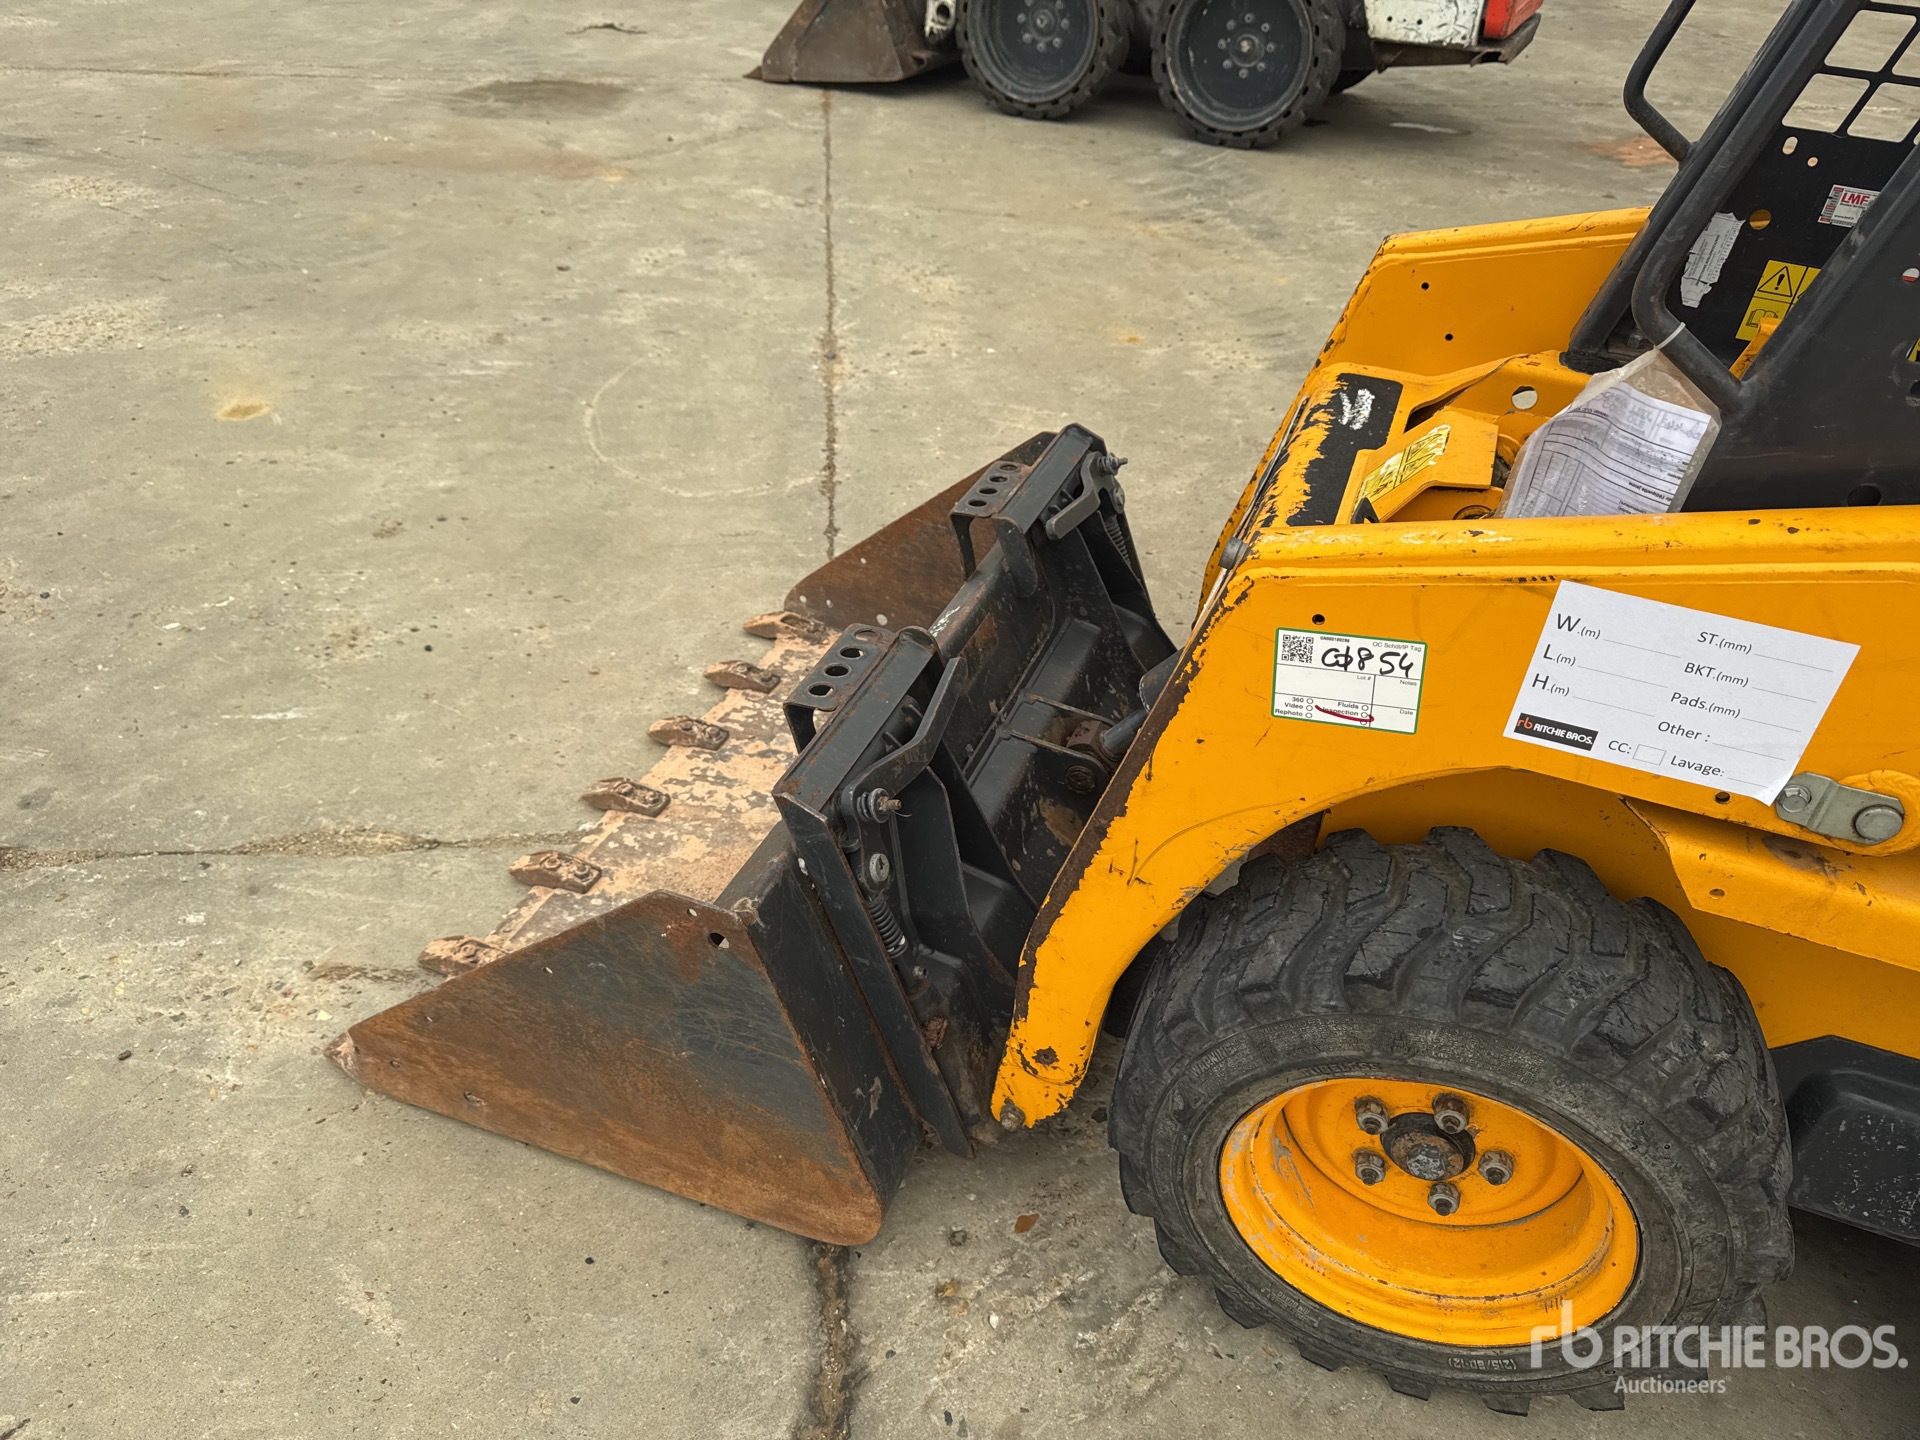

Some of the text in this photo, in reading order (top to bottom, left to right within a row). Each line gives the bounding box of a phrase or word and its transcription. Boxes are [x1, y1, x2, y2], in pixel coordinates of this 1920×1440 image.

[1841, 192, 1870, 205] LMF
[1274, 708, 1303, 717] Rephoto
[1337, 701, 1359, 710] Fluids
[1516, 716, 1593, 745] rb RITCHIE BROS.
[1658, 721, 1702, 740] Other
[1608, 740, 1632, 754] CC:
[1670, 755, 1724, 777] Lavage:
